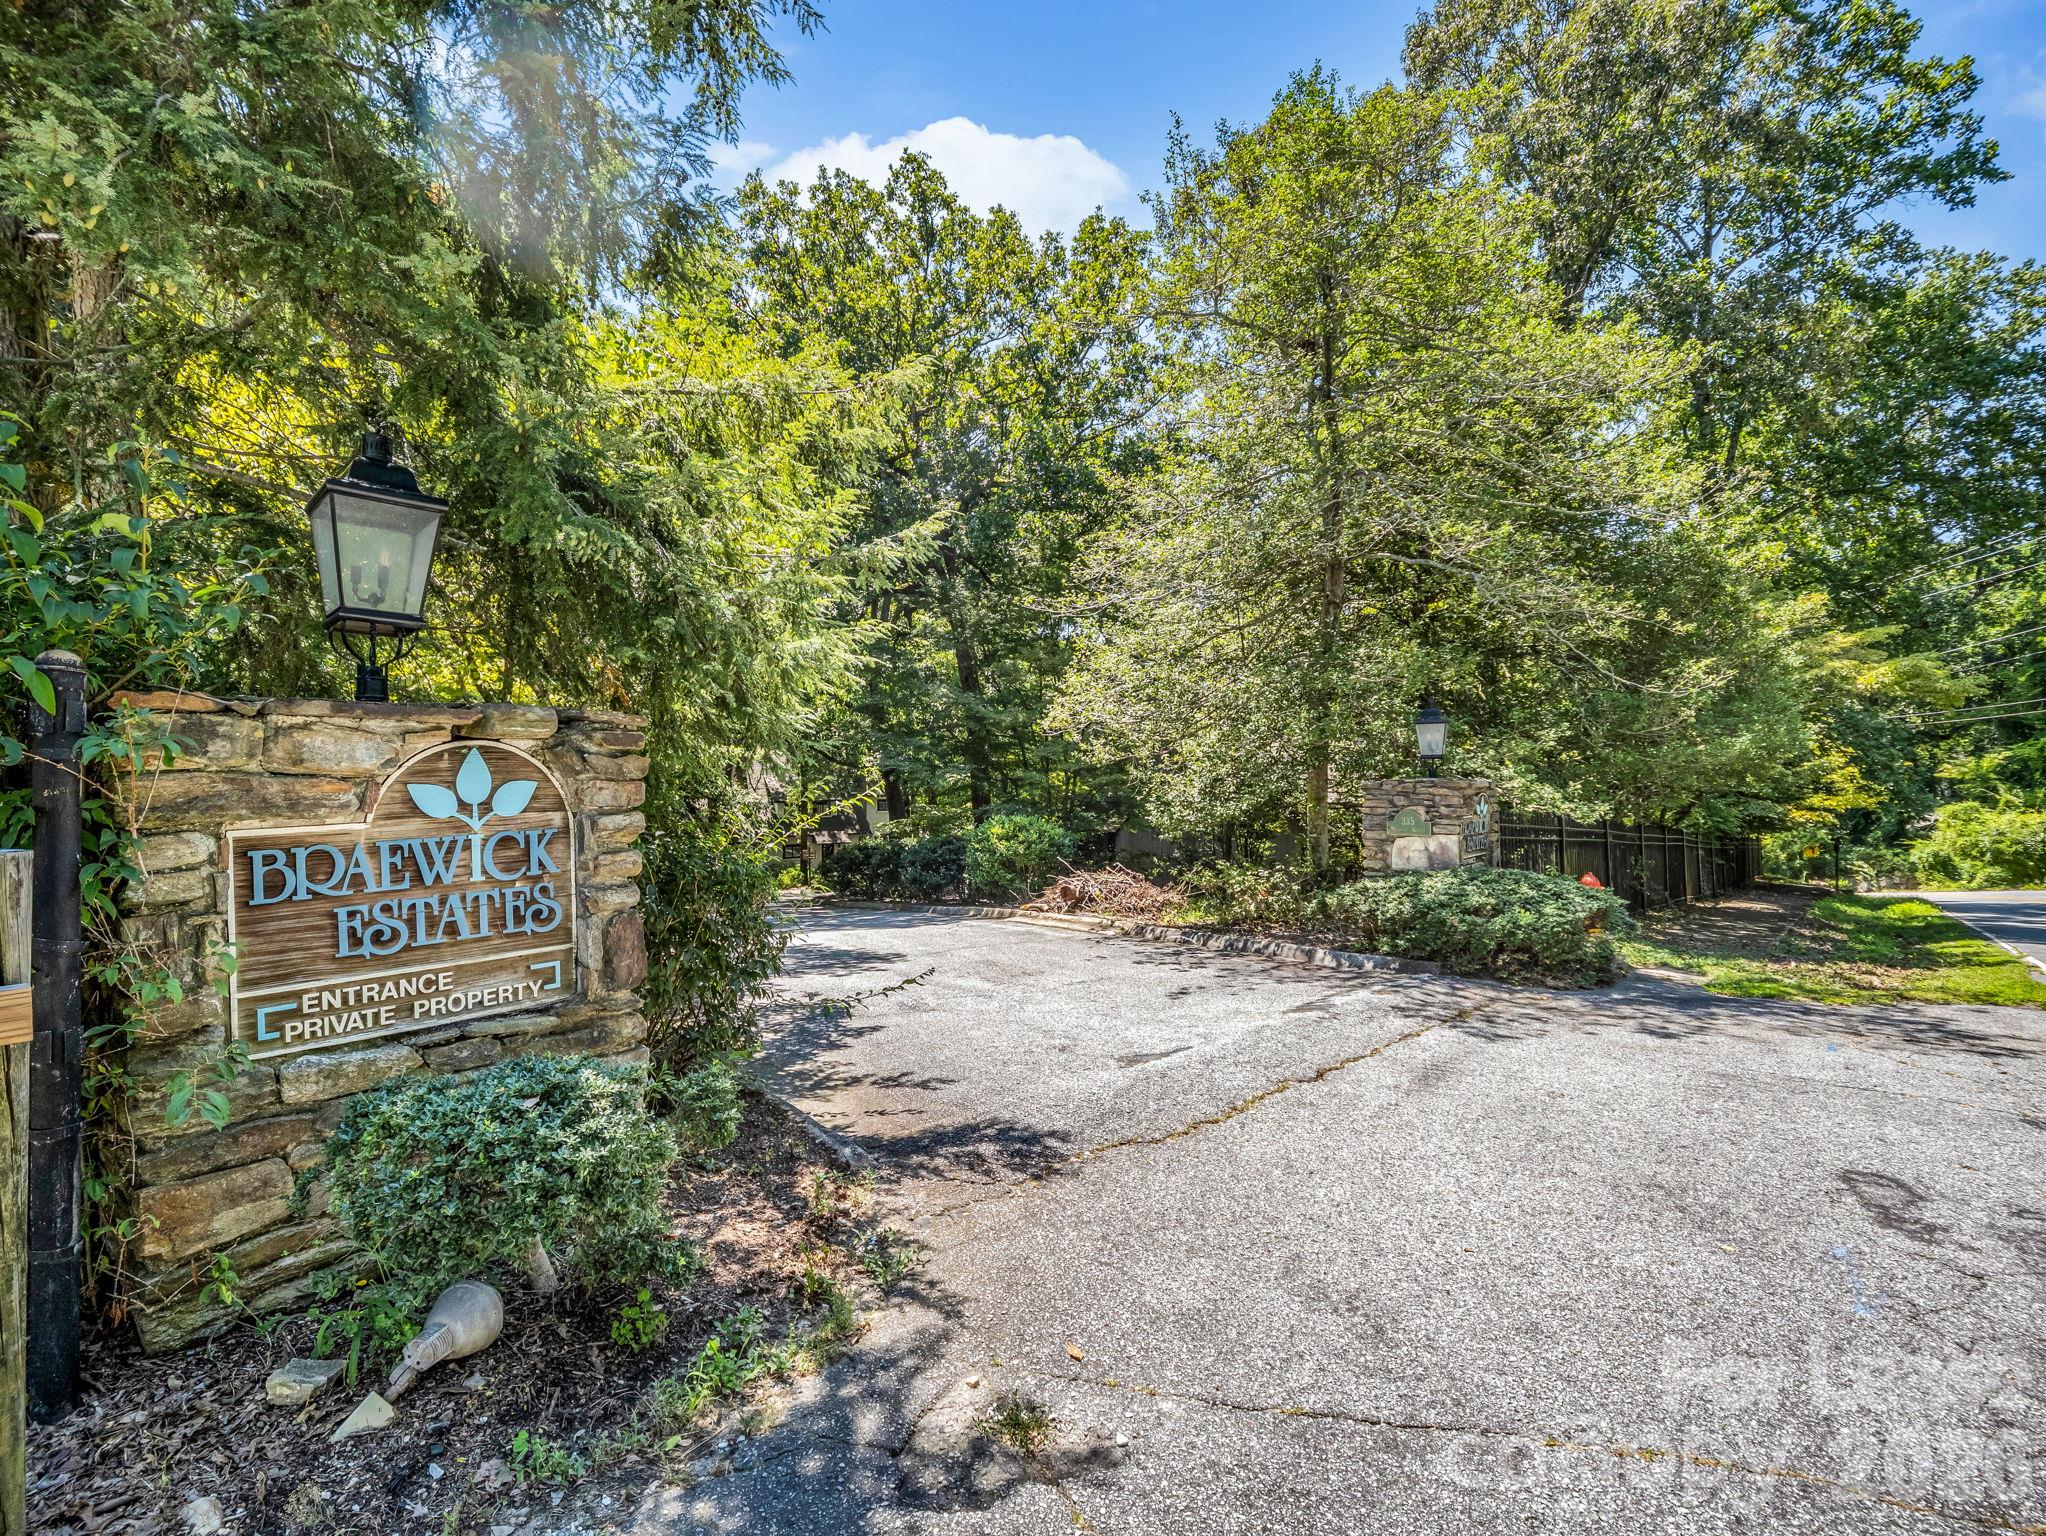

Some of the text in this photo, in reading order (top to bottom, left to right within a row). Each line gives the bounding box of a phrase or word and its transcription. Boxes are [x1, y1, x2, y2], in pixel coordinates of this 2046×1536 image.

[247, 828, 561, 906] BRAEWICK
[333, 881, 563, 959] ESTATES
[284, 979, 543, 1043] PRIVATE PROPERTY
[302, 971, 454, 1015] ENTRANCE
